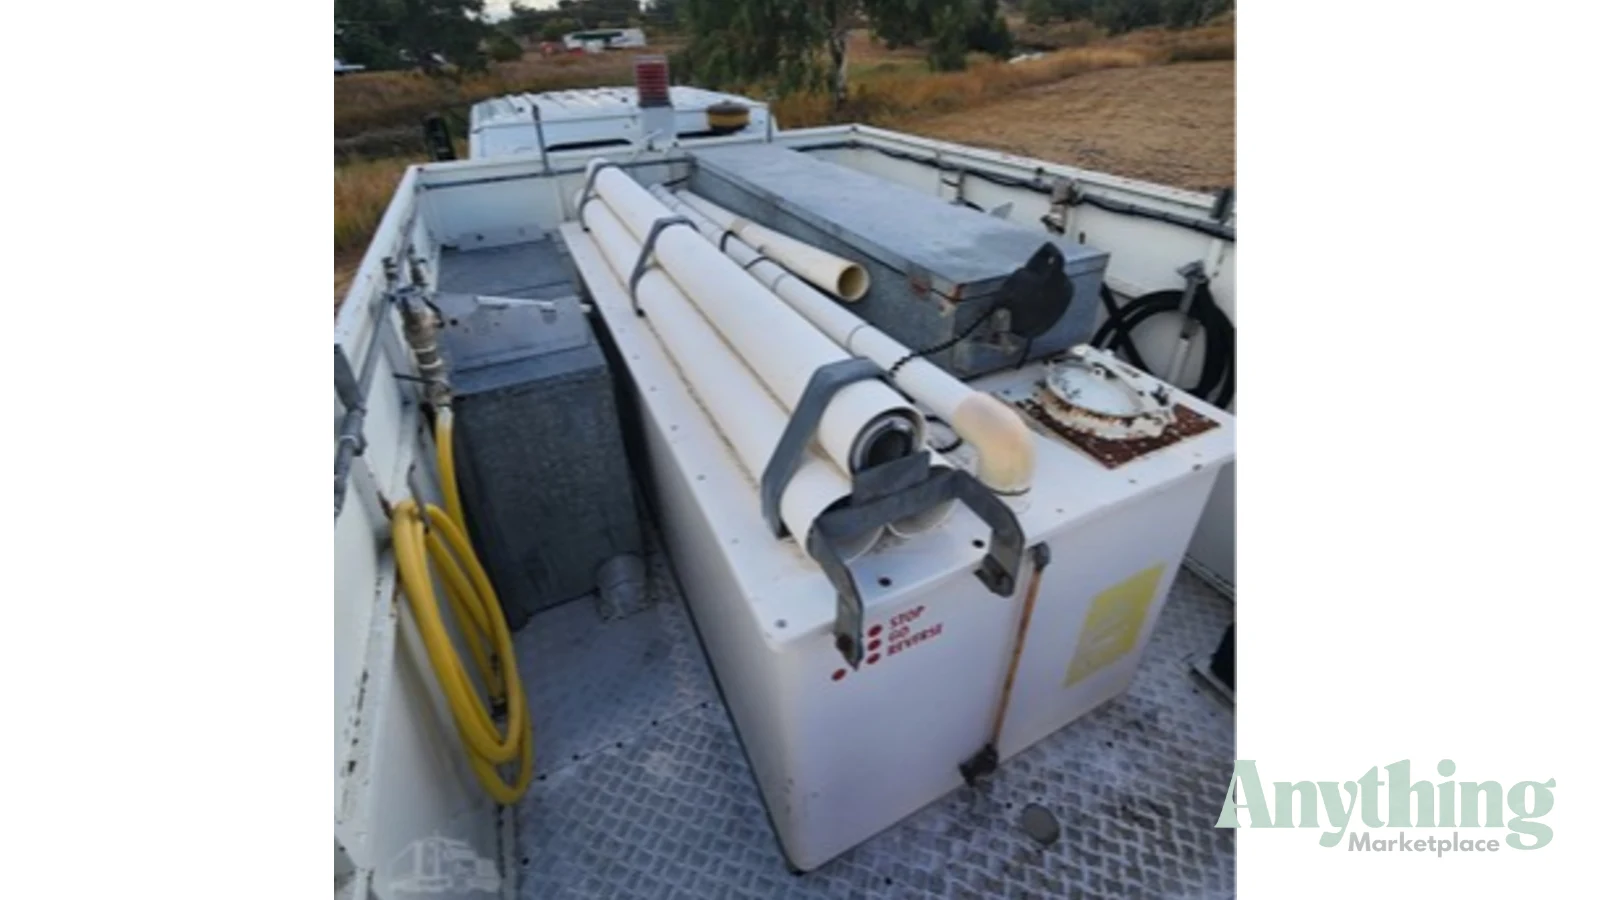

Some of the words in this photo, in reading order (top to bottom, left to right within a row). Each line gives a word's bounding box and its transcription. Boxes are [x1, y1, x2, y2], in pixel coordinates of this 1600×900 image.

[889, 605, 926, 629] STOP
[886, 622, 943, 657] REVERSE
[888, 625, 910, 643] GO
